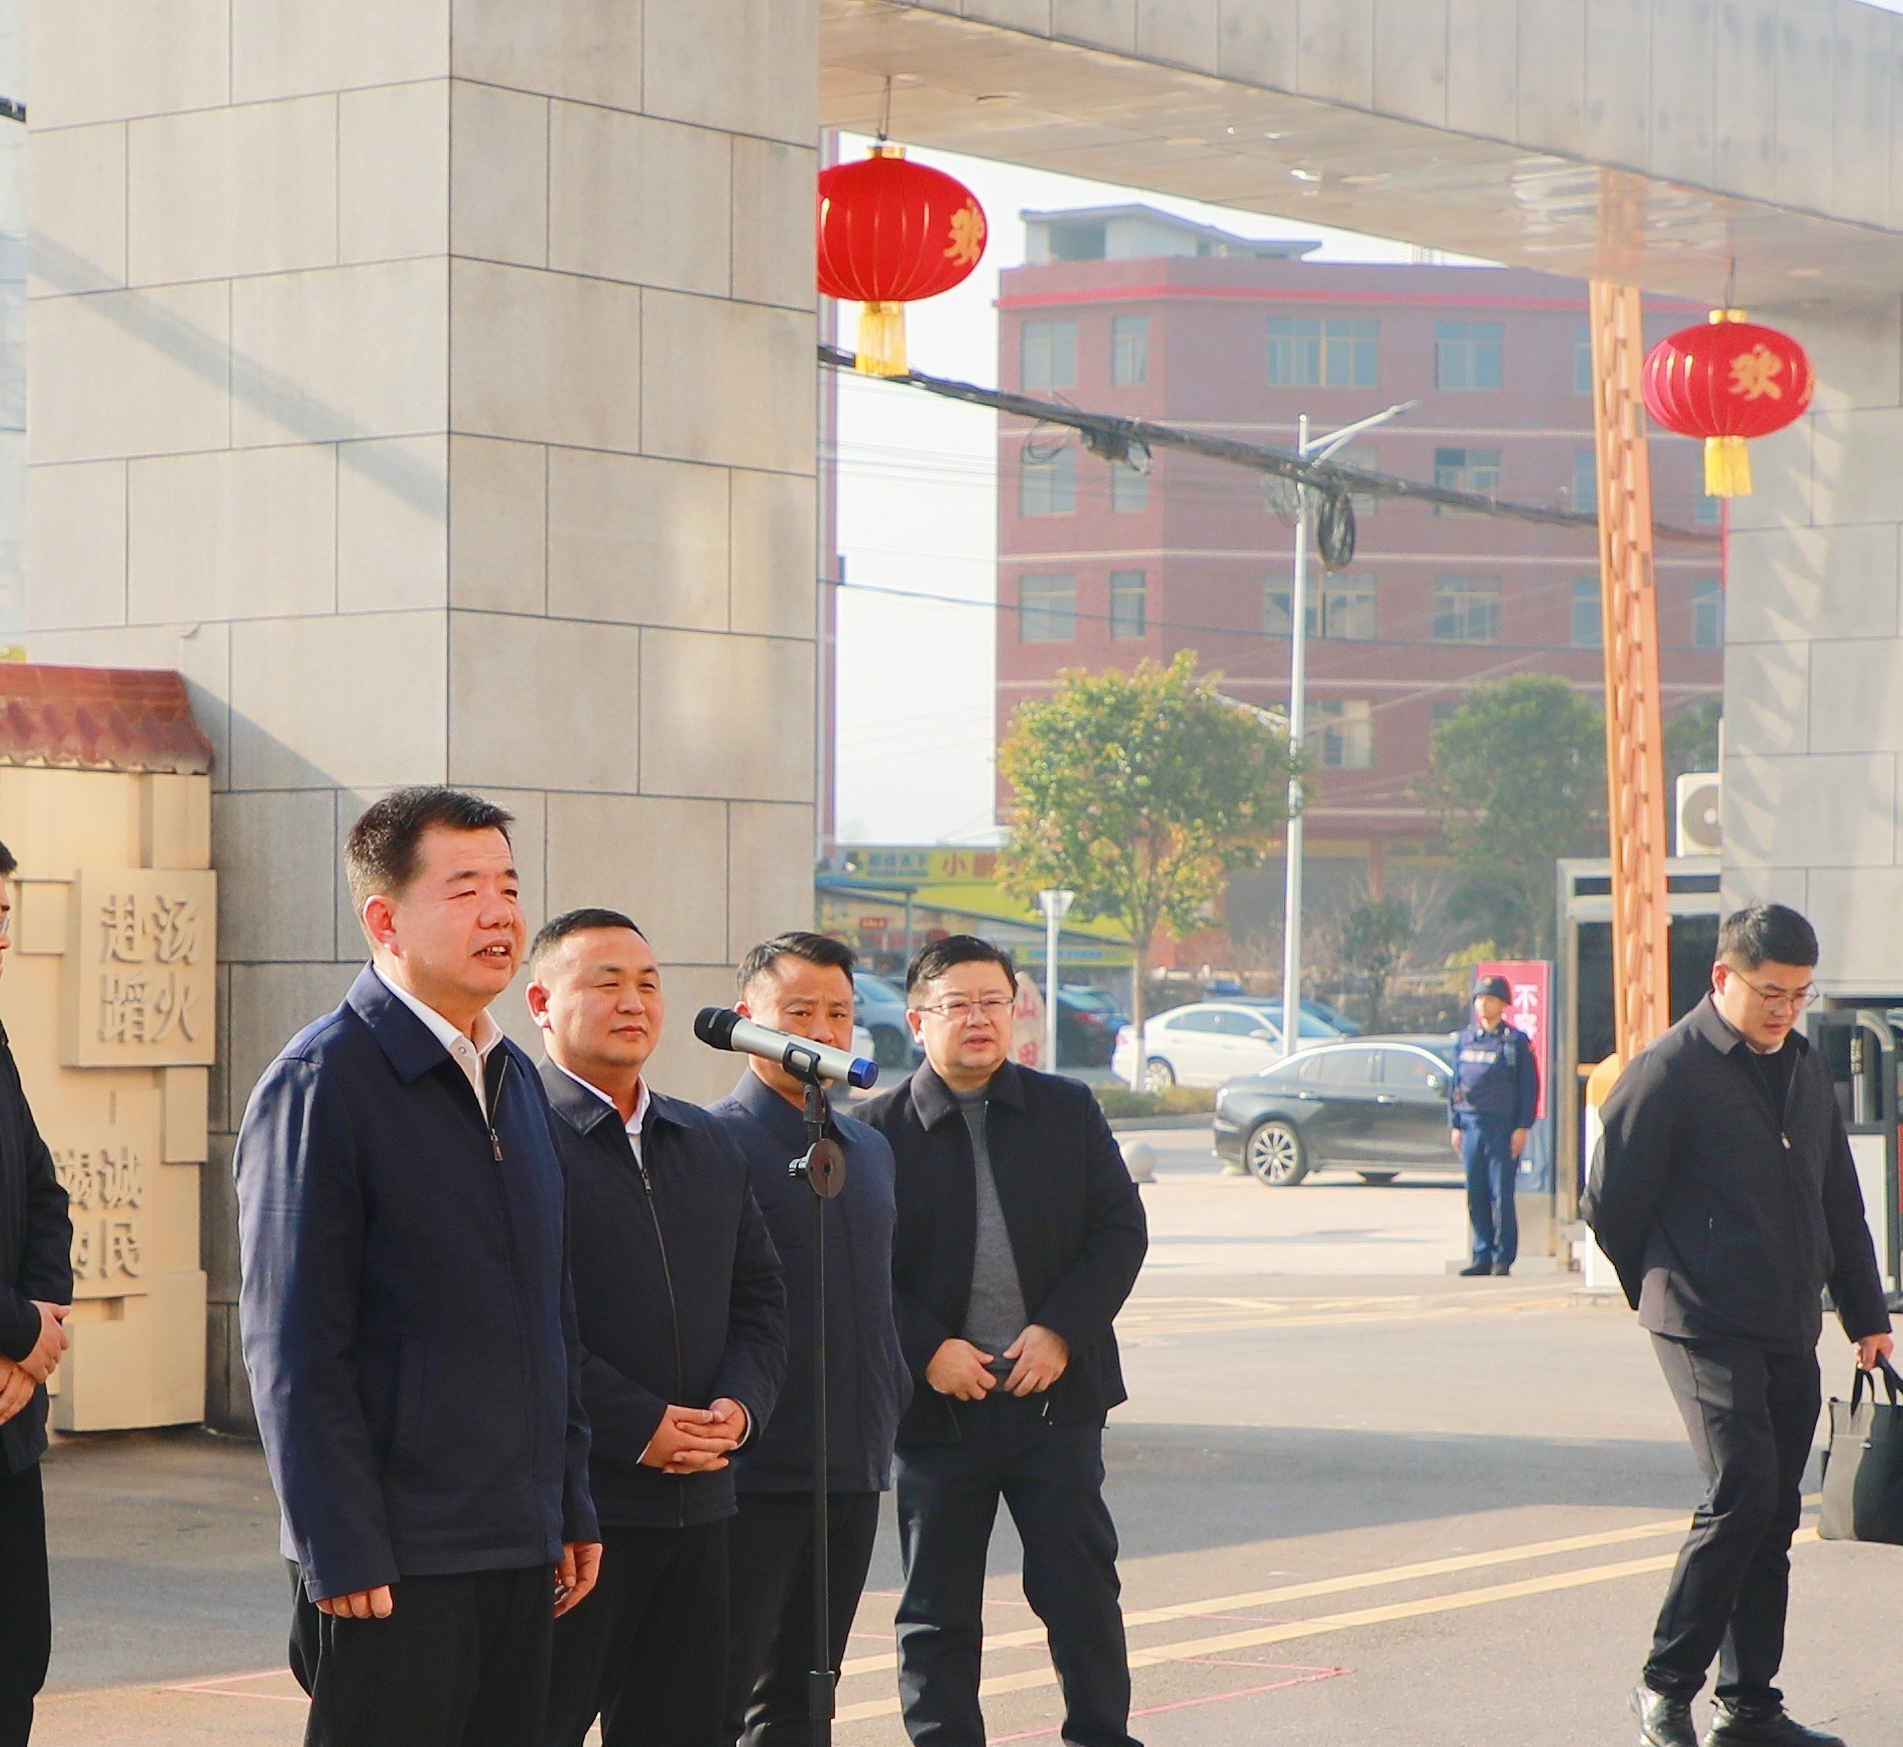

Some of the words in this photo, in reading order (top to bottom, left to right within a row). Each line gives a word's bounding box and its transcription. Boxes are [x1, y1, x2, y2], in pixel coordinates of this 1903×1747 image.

[99, 894, 198, 966] 赴汤
[98, 971, 198, 1044] 蹈火
[52, 1147, 142, 1211] 竭诚
